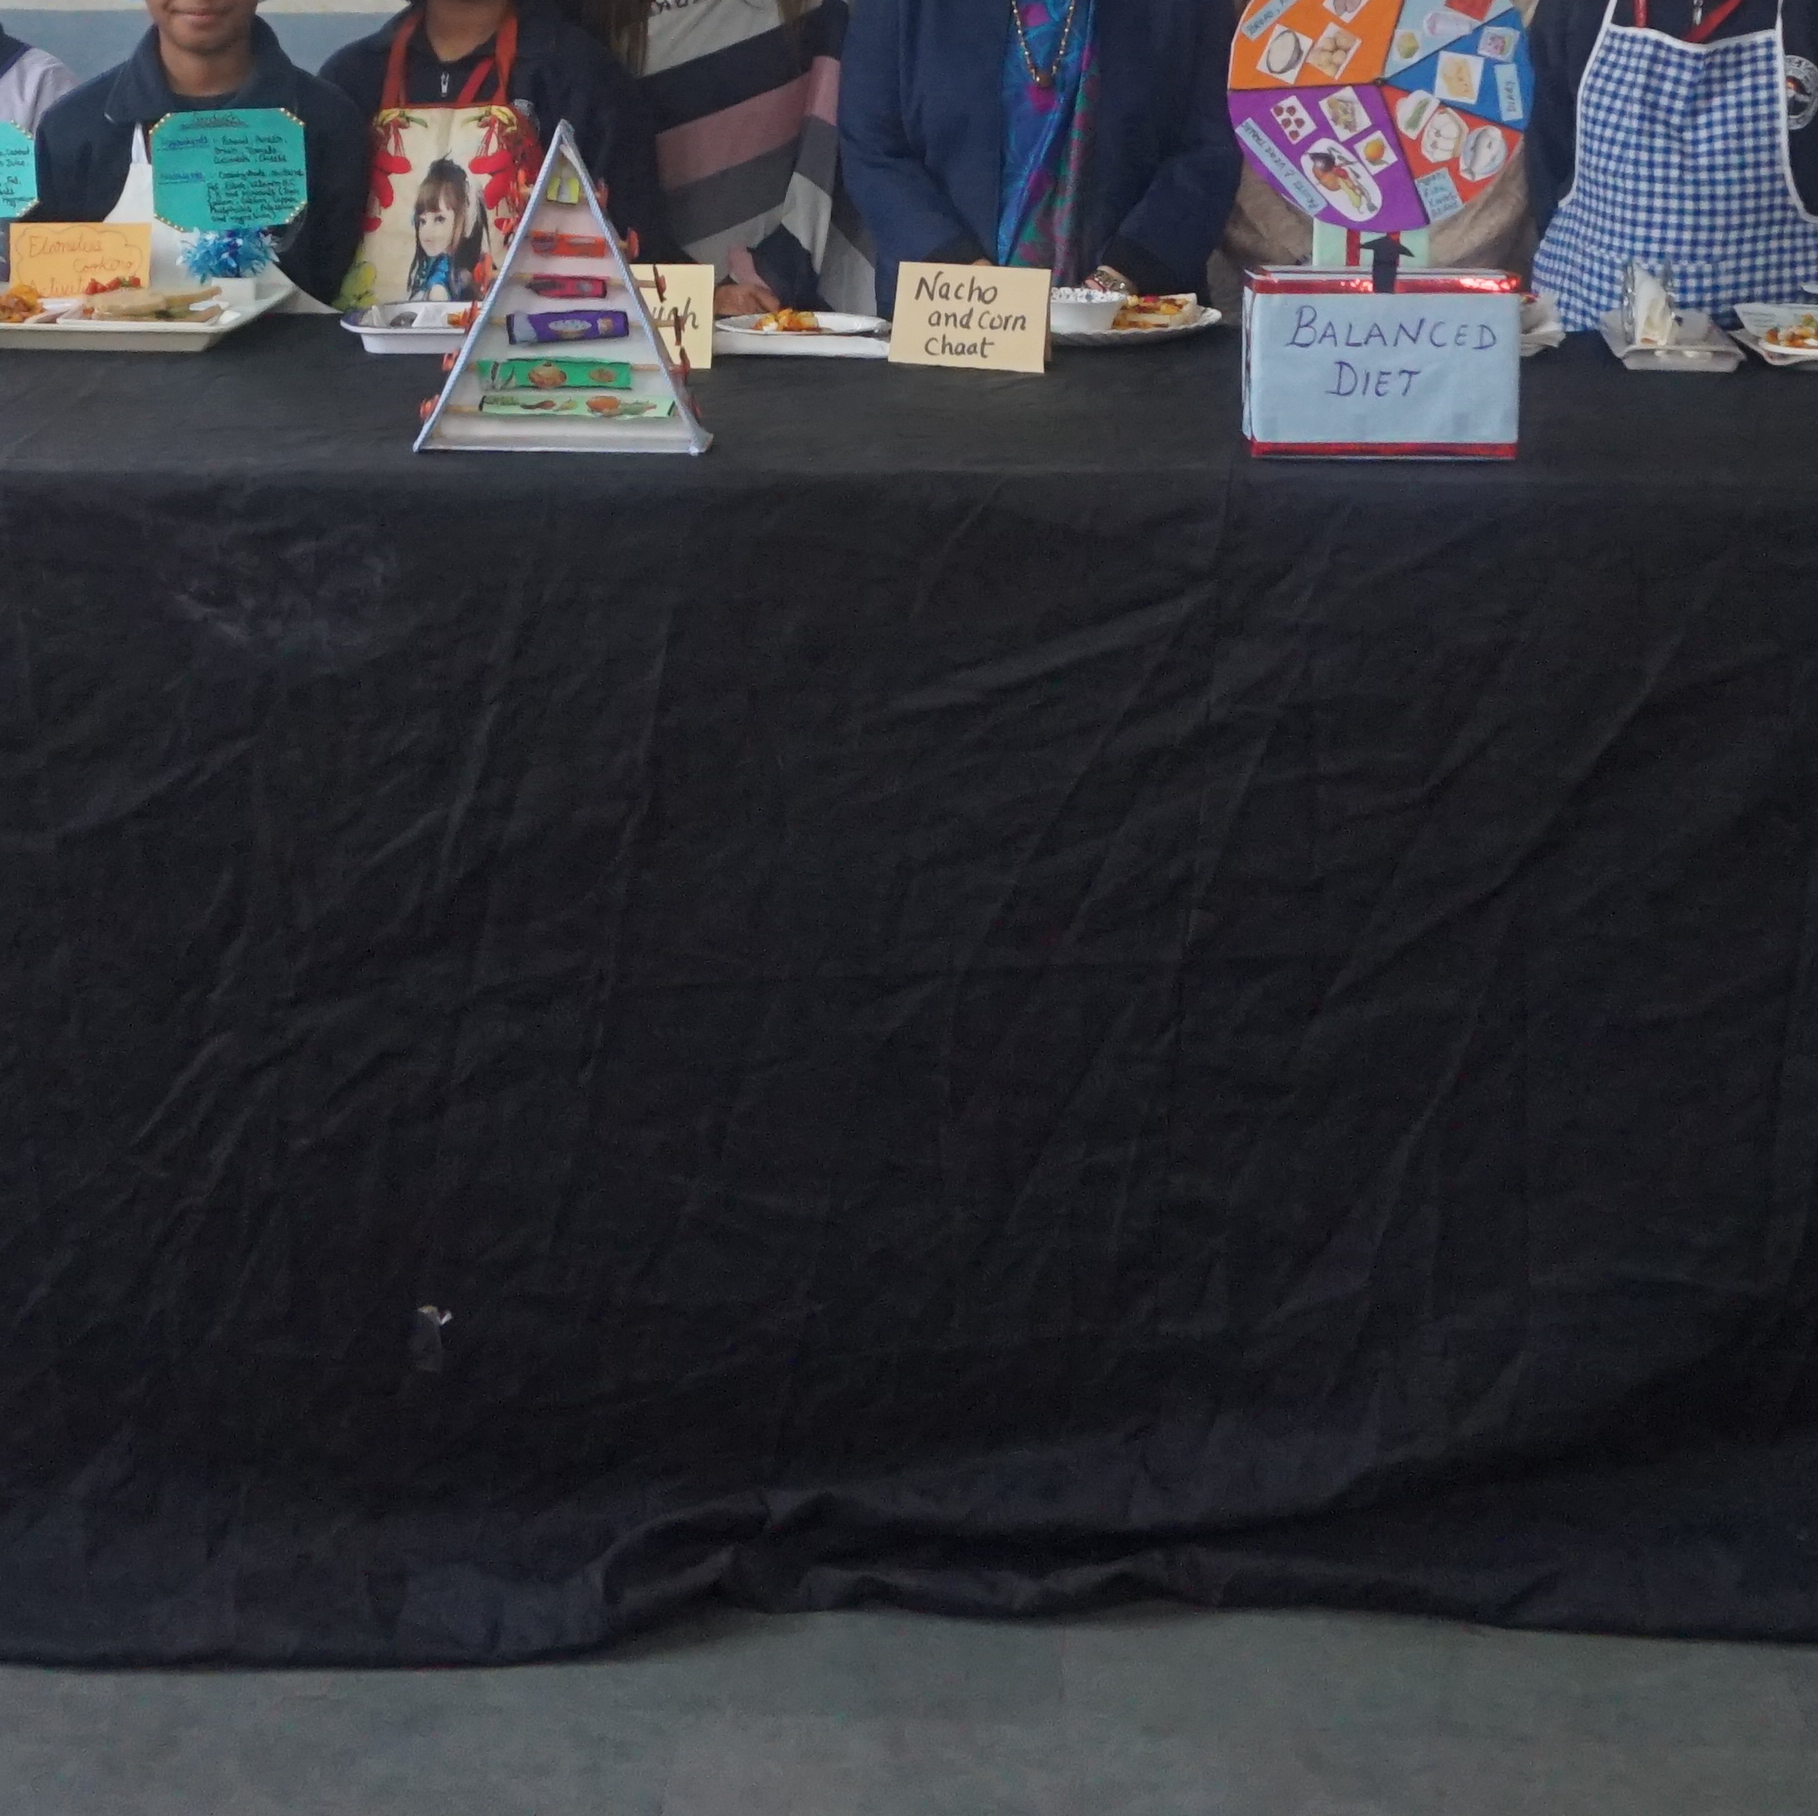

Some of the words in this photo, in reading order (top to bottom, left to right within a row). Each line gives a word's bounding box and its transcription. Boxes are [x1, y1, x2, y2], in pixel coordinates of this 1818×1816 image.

[914, 270, 998, 305] Nacho
[928, 307, 974, 330] and
[1285, 305, 1497, 350] BALANCED
[1325, 361, 1421, 396] DIET
